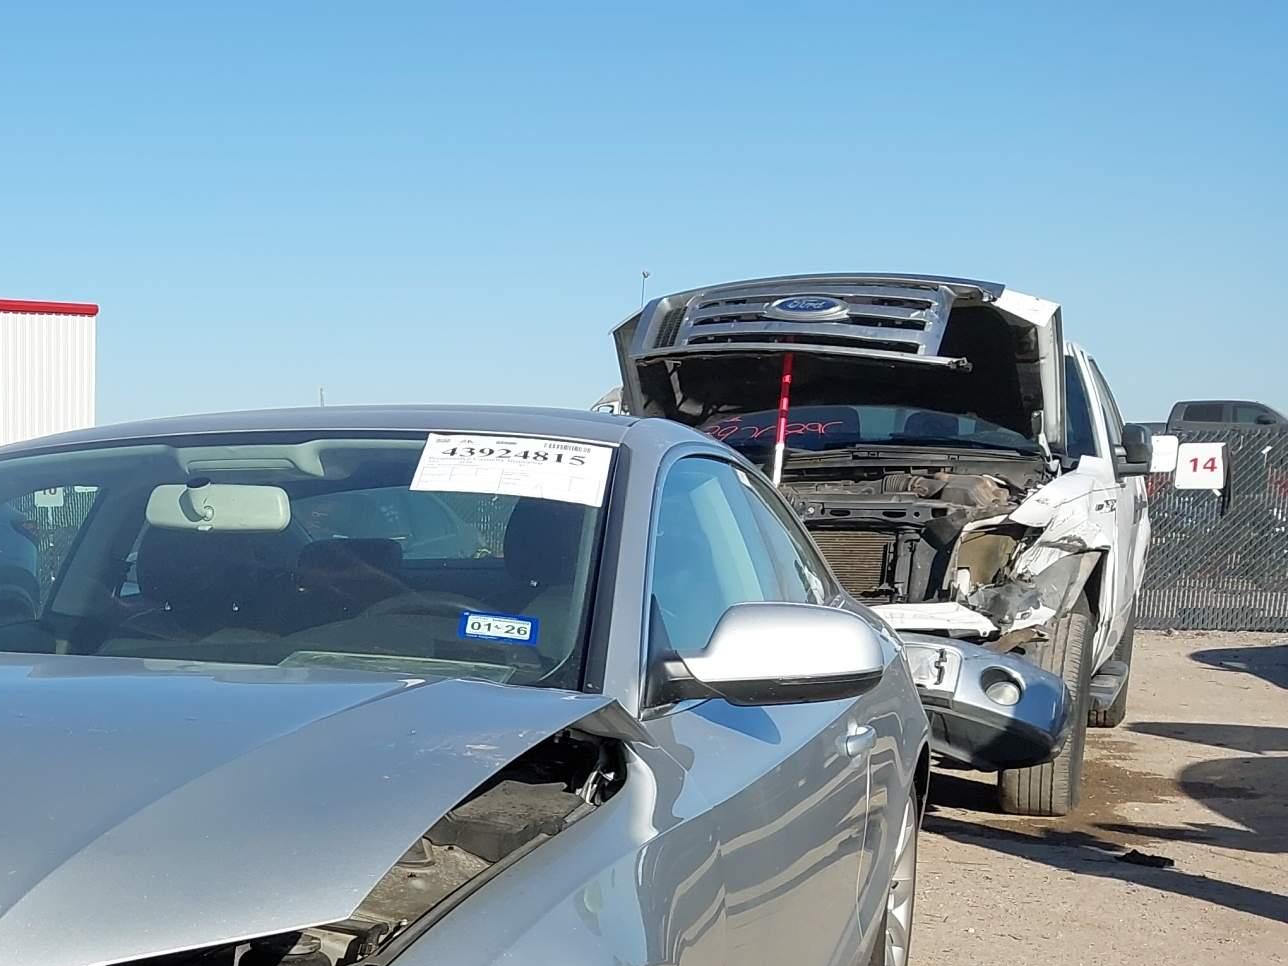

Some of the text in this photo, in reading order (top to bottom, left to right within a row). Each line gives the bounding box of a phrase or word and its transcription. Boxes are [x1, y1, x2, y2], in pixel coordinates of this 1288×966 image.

[787, 299, 828, 310] Ford
[441, 447, 587, 466] 43924815
[1189, 457, 1218, 473] 14
